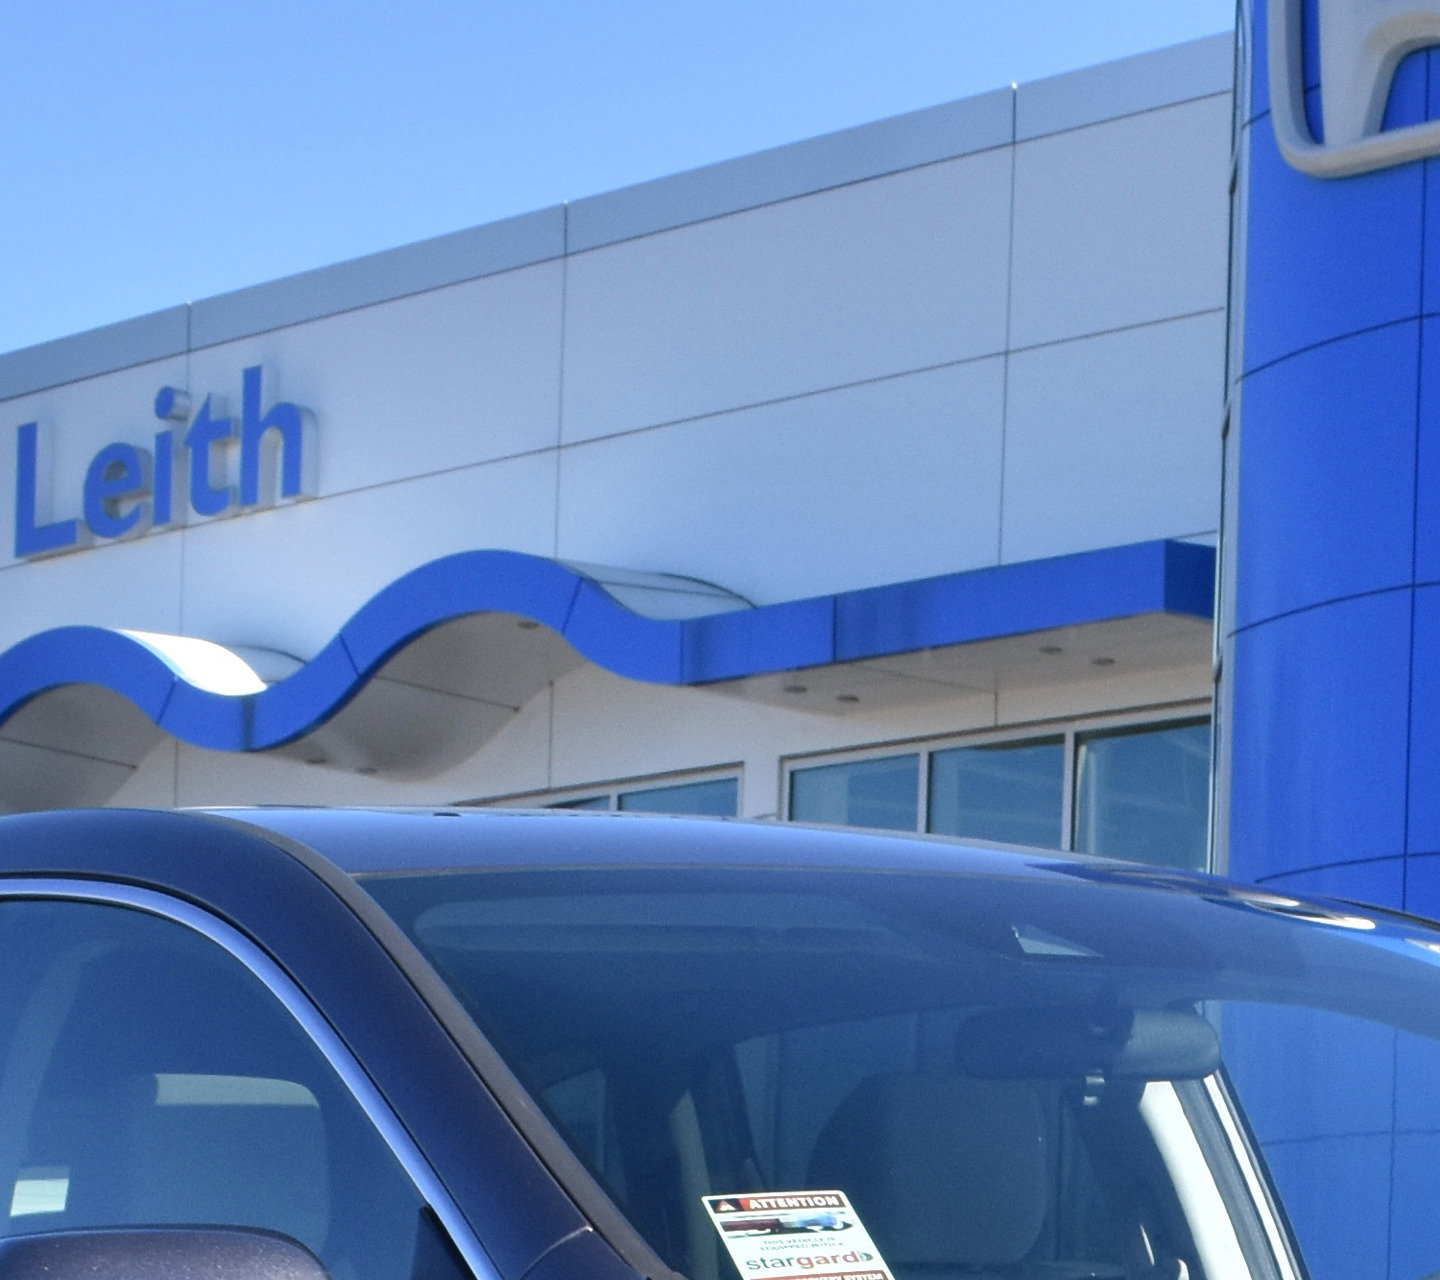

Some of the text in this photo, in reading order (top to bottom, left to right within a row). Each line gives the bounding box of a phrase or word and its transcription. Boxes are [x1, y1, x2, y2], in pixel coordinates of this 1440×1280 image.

[15, 364, 312, 558] Leith
[750, 1195, 839, 1209] ATTENTION
[746, 1251, 860, 1270] stargard
